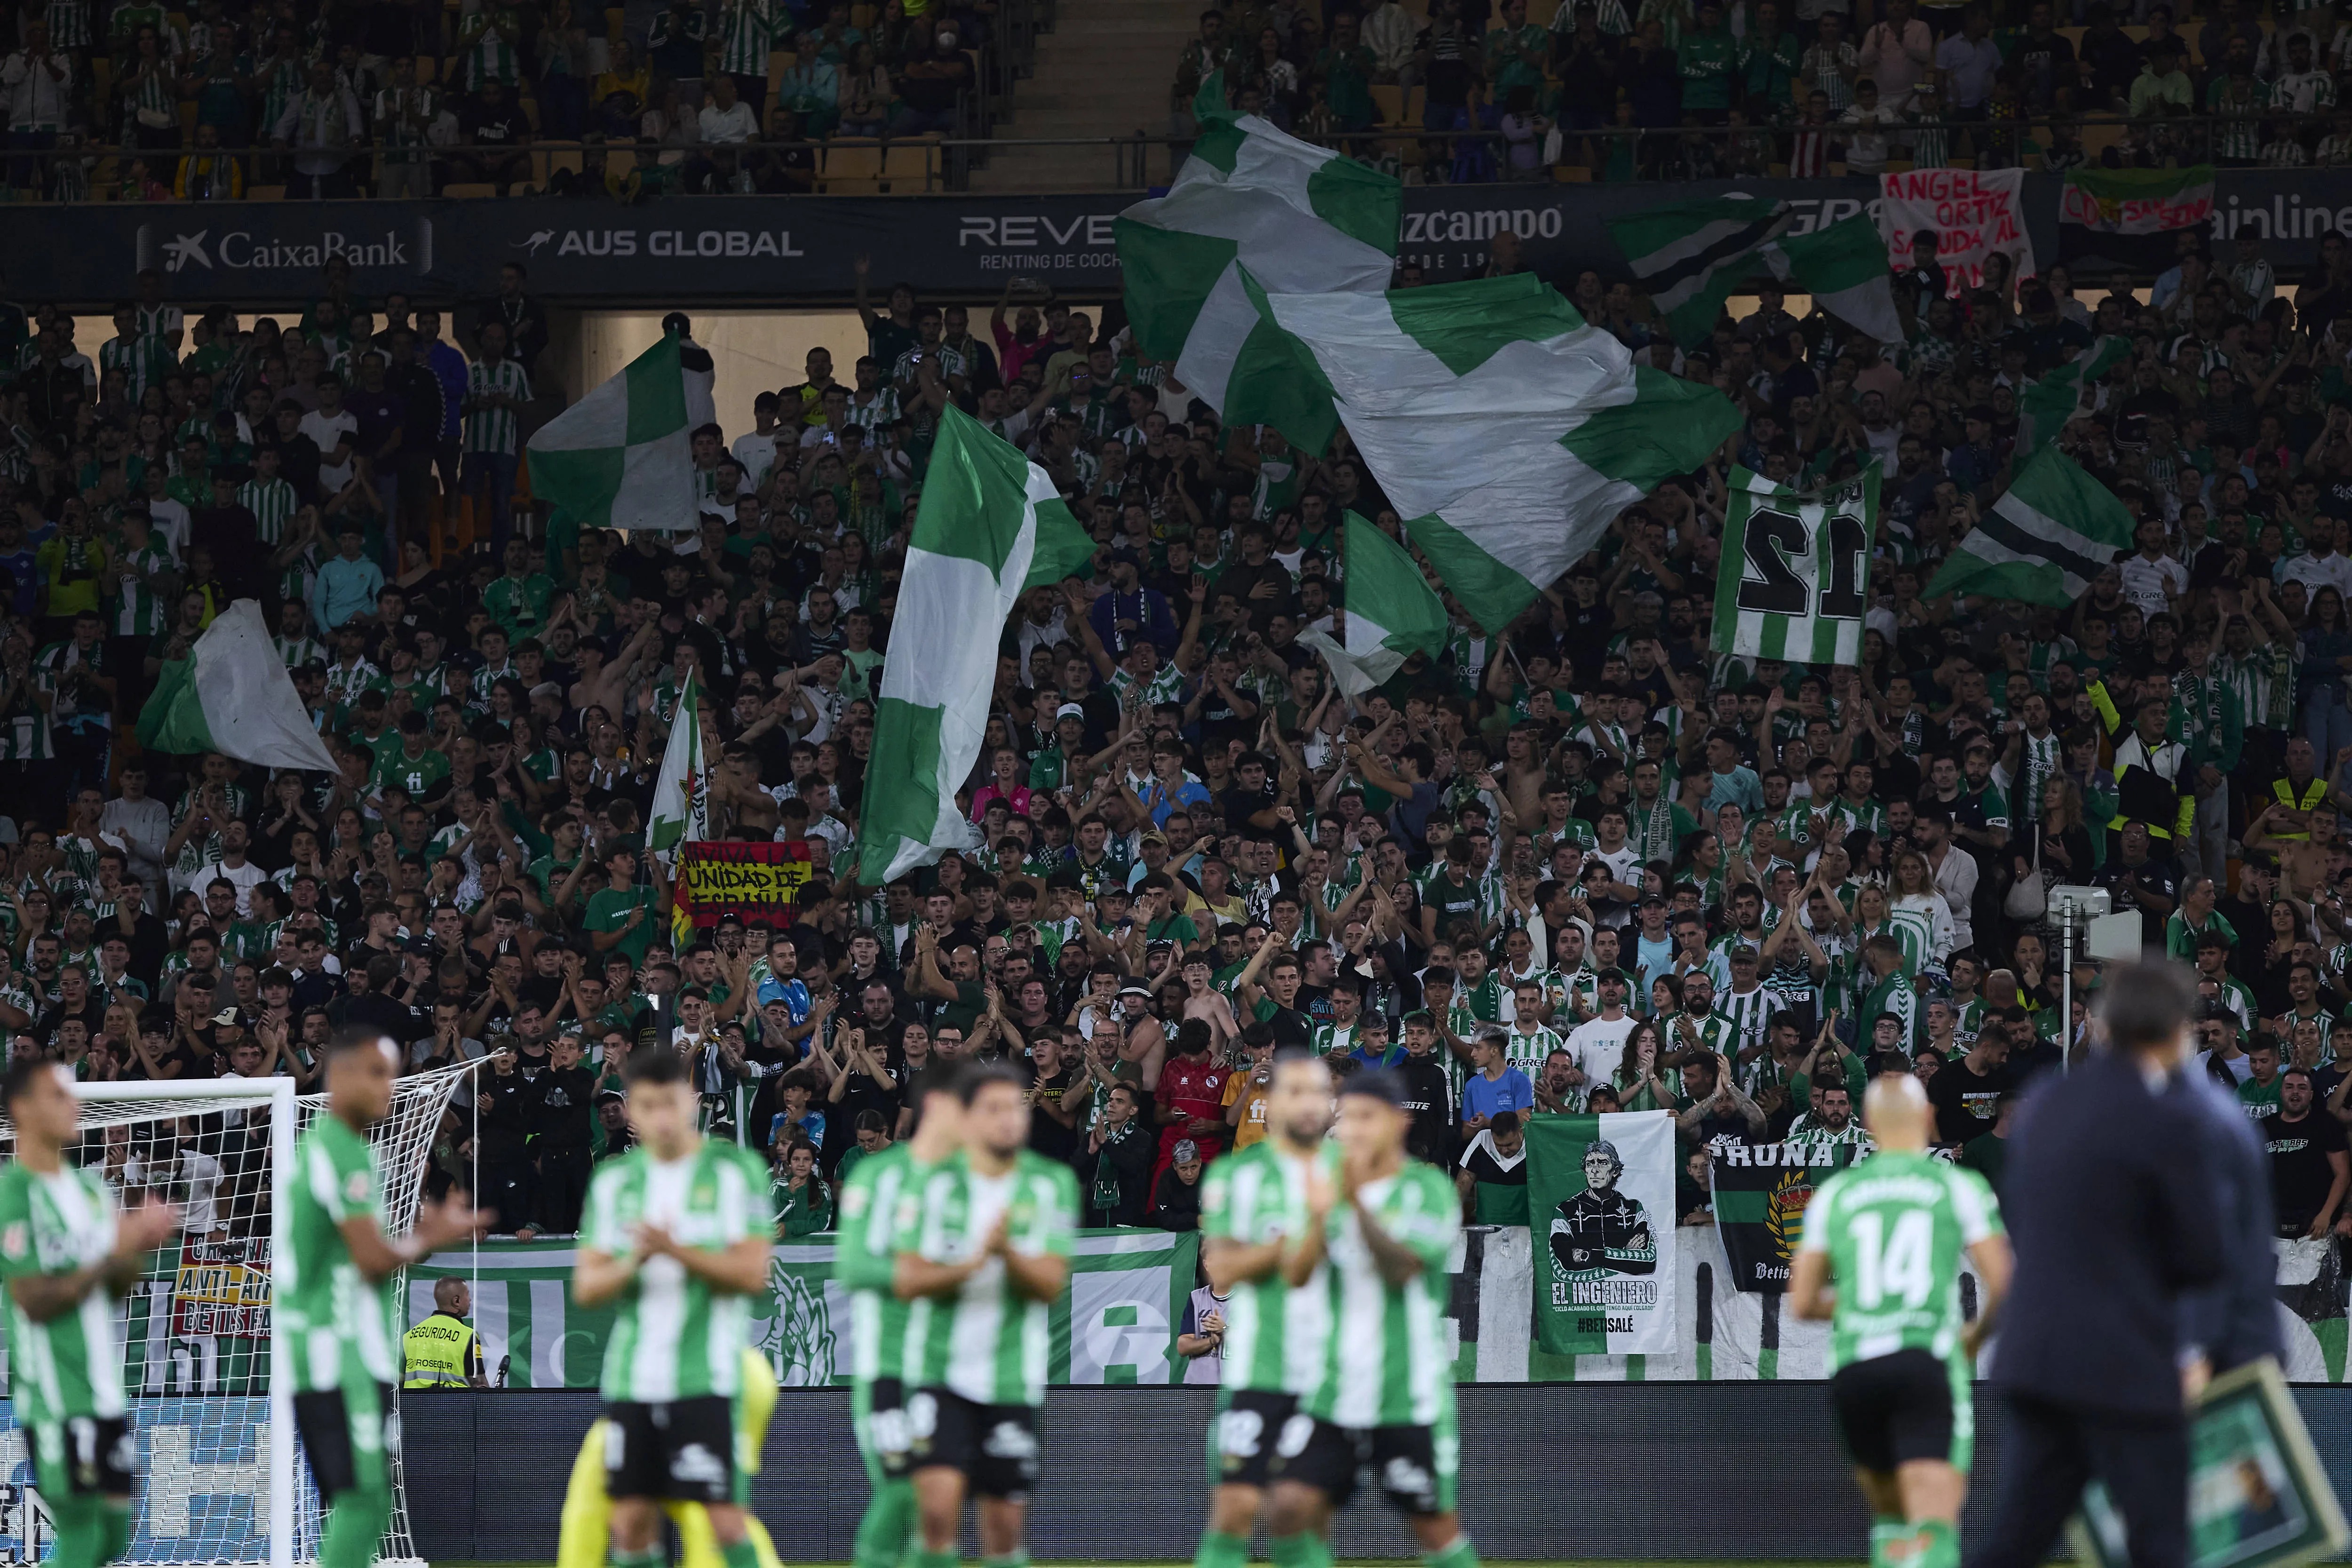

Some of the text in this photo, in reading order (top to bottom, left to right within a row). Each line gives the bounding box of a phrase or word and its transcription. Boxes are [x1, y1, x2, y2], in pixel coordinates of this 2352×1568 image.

[1886, 172, 1990, 201] ANGEL
[1937, 190, 2010, 227] ORTIZ
[959, 215, 1119, 246] REVE
[1995, 215, 2020, 244] AL
[218, 231, 408, 268] CaixaBank
[557, 230, 804, 257] AUS GLOBAL
[980, 255, 1050, 269] RENTING
[1054, 254, 1077, 269] DE
[1394, 254, 1445, 270] ESDE
[406, 772, 421, 790] fi
[766, 845, 797, 868] LA
[686, 867, 803, 889] UNIDAD DE
[1788, 991, 1810, 1002] GREE
[1250, 1099, 1267, 1119] fi
[1755, 1262, 1793, 1280] Betis,
[1849, 1209, 1935, 1311] 14
[1551, 1280, 1658, 1305] EL INGENIERO
[183, 1301, 245, 1334] BETIS
[1577, 1315, 1634, 1333] #BETISALÉ
[410, 1326, 460, 1342] SEGURIDAD
[414, 1359, 453, 1370] ROSEGUR
